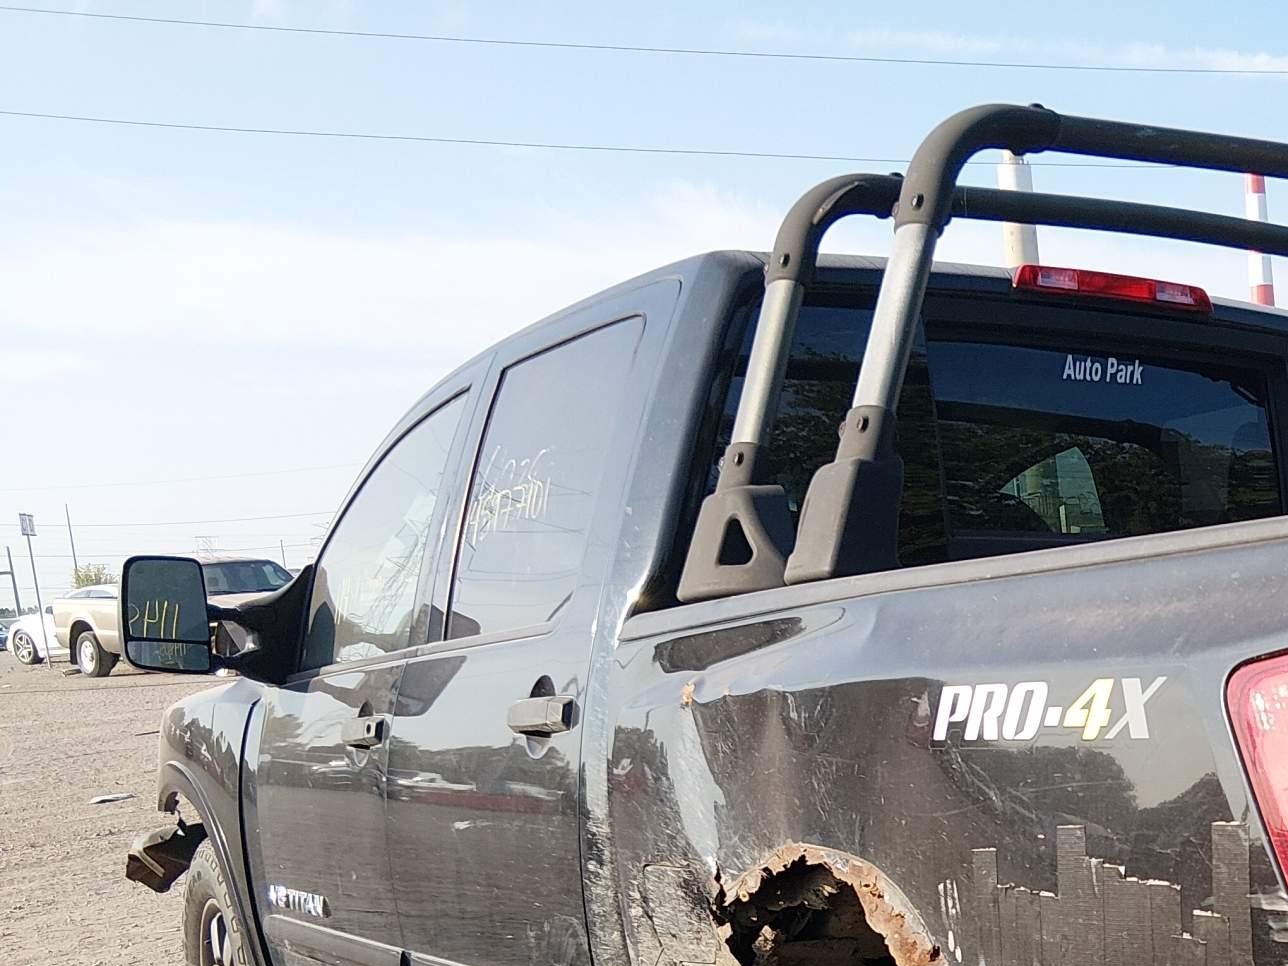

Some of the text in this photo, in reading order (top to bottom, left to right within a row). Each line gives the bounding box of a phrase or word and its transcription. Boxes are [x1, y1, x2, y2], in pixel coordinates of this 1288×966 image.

[1062, 354, 1144, 385] Auto Park
[932, 676, 1168, 741] PRO-4X
[286, 888, 325, 917] TITAN
